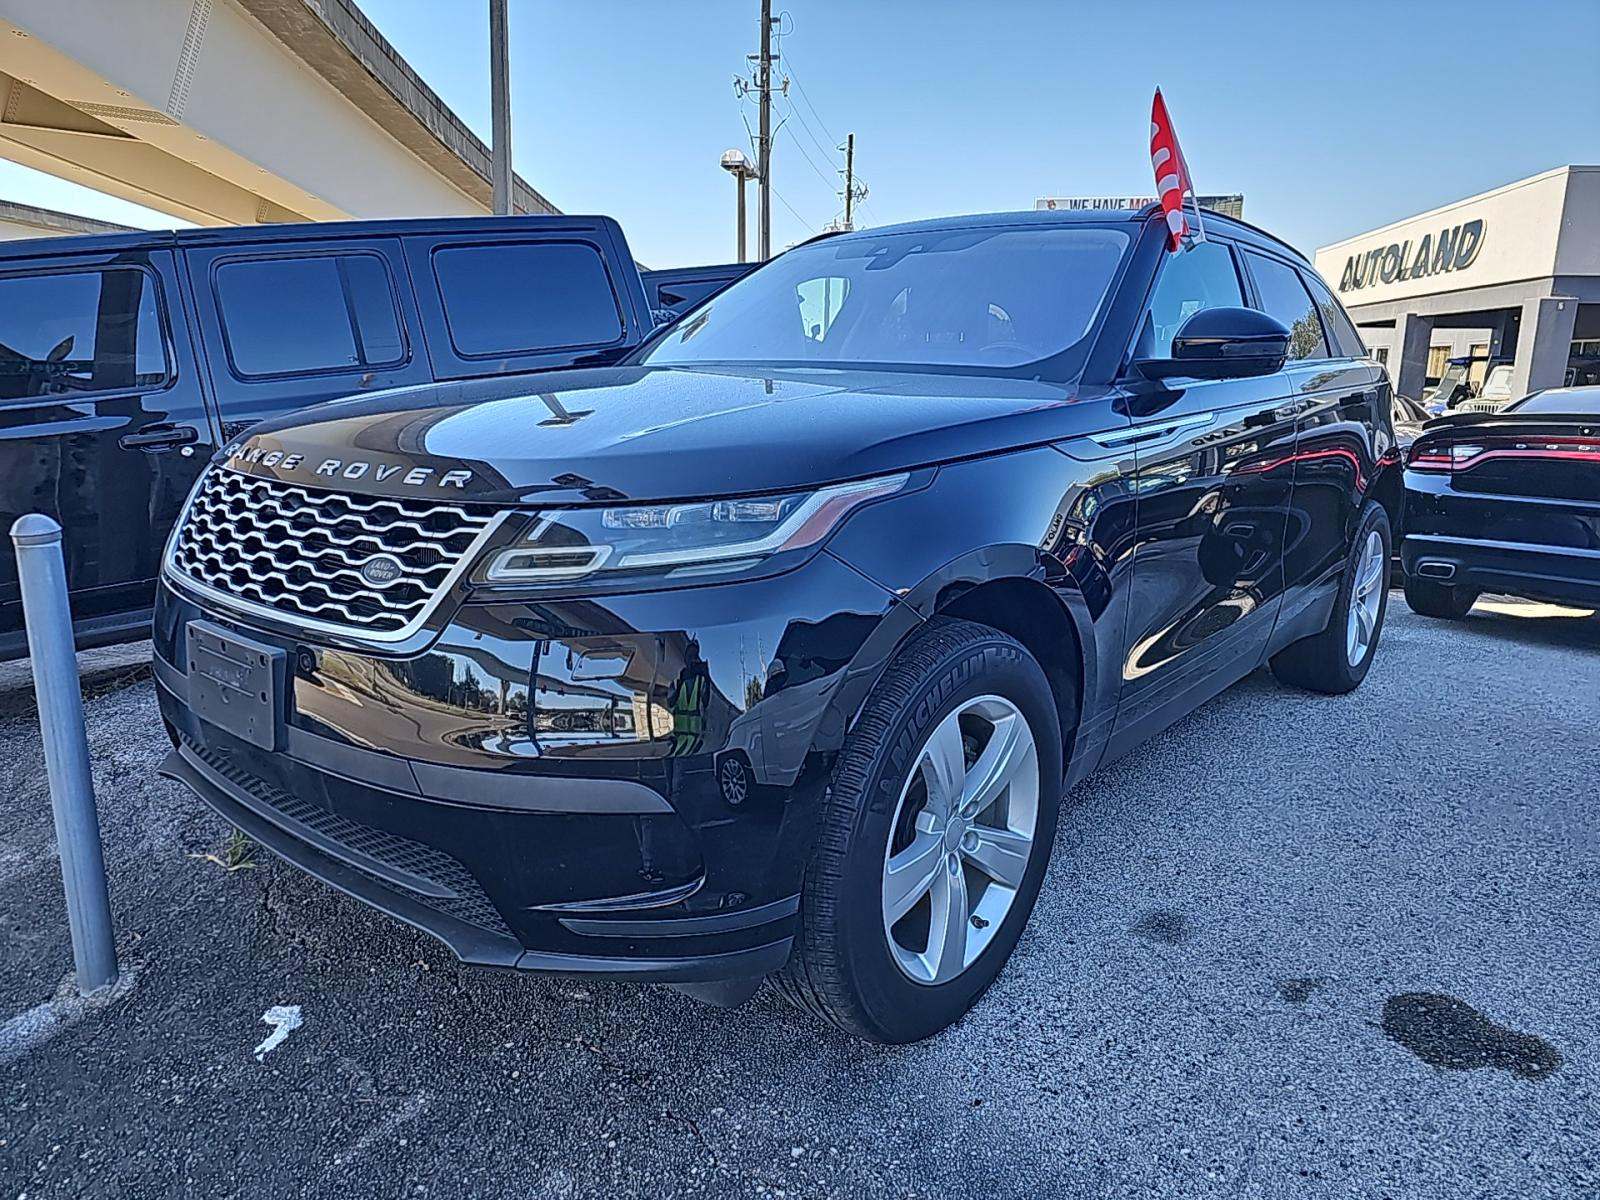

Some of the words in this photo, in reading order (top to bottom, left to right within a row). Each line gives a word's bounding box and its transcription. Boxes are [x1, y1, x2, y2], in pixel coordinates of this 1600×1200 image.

[1069, 198, 1089, 210] WE
[1093, 197, 1126, 210] HAVE
[1338, 218, 1488, 293] AUTOLAND
[224, 442, 304, 470] RANGE
[316, 459, 473, 488] ROVER
[891, 652, 985, 770] MICHELIN
